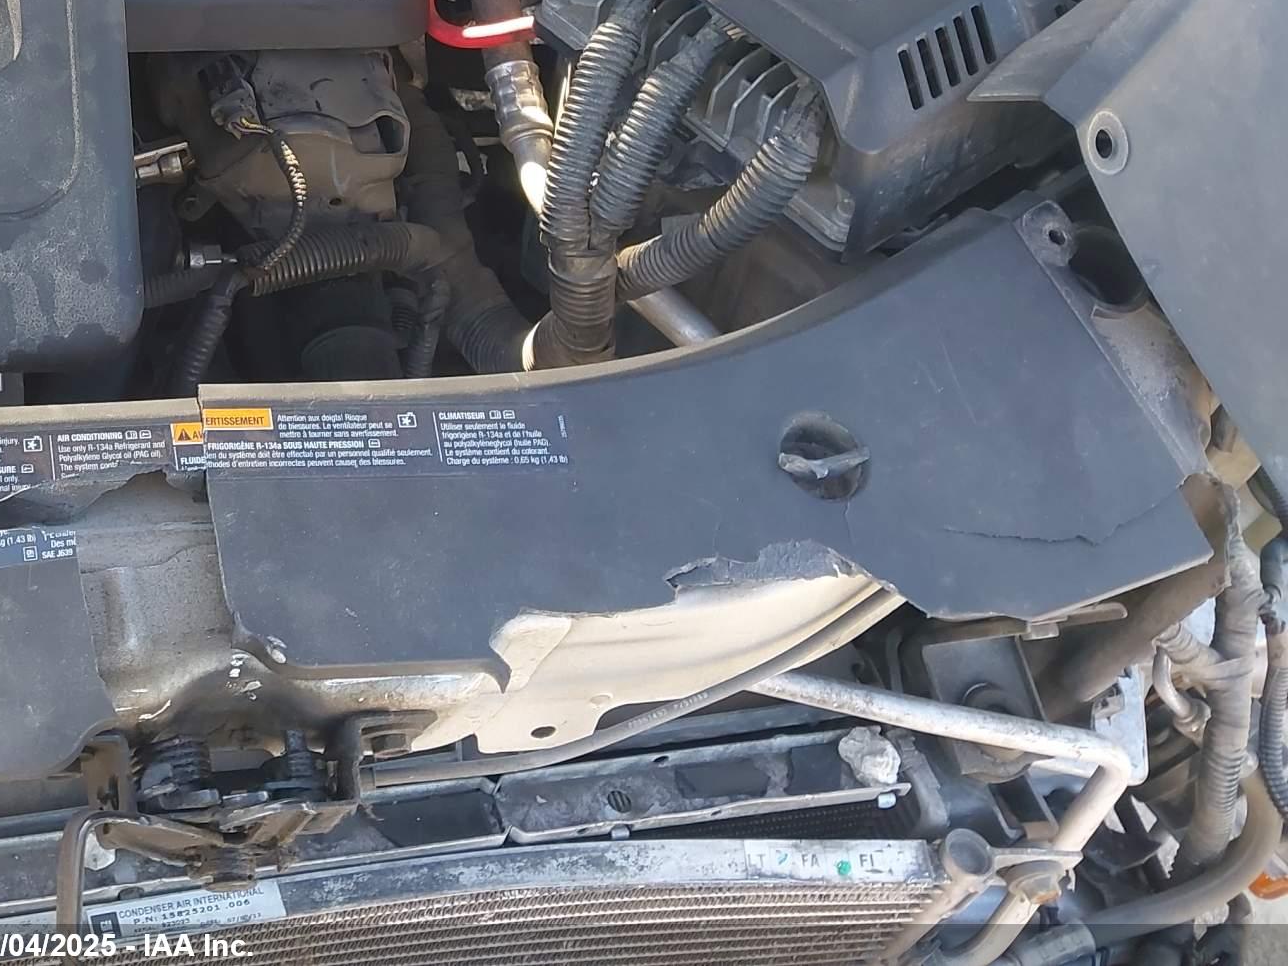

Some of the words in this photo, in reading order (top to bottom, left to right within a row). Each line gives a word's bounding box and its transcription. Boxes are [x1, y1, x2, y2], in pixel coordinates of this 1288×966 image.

[277, 414, 306, 422] Attention
[345, 414, 367, 422] Risque
[439, 412, 485, 420] CLIMATISEUR
[289, 422, 321, 430] blessures.
[323, 422, 331, 430] Le
[332, 422, 366, 430] ventilateur
[369, 422, 383, 430] peut
[57, 434, 69, 442] AIR
[72, 432, 122, 441] CONDITIONING
[280, 430, 301, 438] mettre
[309, 430, 332, 438] tourner
[0, 437, 19, 446] injury.
[208, 441, 254, 450] FRIGORIGÈNE
[257, 442, 282, 450] R-134a
[283, 441, 302, 449] SOUS
[304, 441, 327, 449] HAUTE
[329, 440, 364, 448] PRESSION
[58, 445, 71, 453] Use
[72, 445, 86, 453] only
[88, 443, 112, 451] R-134a
[115, 442, 151, 451] Refrigerant
[152, 440, 165, 448] and
[59, 454, 100, 463] Polyalkylene
[102, 453, 122, 461] Glycol
[134, 450, 149, 459] (PAG
[229, 451, 256, 459] système
[258, 450, 270, 458] doit
[272, 450, 284, 458] être
[315, 451, 326, 459] par
[338, 450, 370, 458] personnel
[372, 449, 395, 458] qualifié
[397, 449, 432, 457] seulement.
[455, 449, 482, 457] système
[181, 457, 206, 465] FLUIDE
[232, 459, 267, 467] d'entretien
[268, 458, 306, 467] incorrectes
[307, 459, 334, 468] peuvent
[359, 458, 371, 466] des
[373, 458, 406, 466] blessures.
[447, 457, 470, 466] Charge
[482, 457, 509, 465] système
[514, 456, 529, 464] 0,65
[531, 456, 539, 465] kg
[560, 455, 568, 464] lb)
[75, 463, 98, 471] system
[7, 536, 25, 546] (1.43
[27, 534, 36, 544] lb)
[51, 540, 65, 548] Des
[42, 551, 55, 559] SAE
[57, 550, 73, 558] J639
[118, 902, 174, 919] CONDENSER
[176, 899, 192, 908] AIR
[194, 886, 264, 905] INTERNATIONAL
